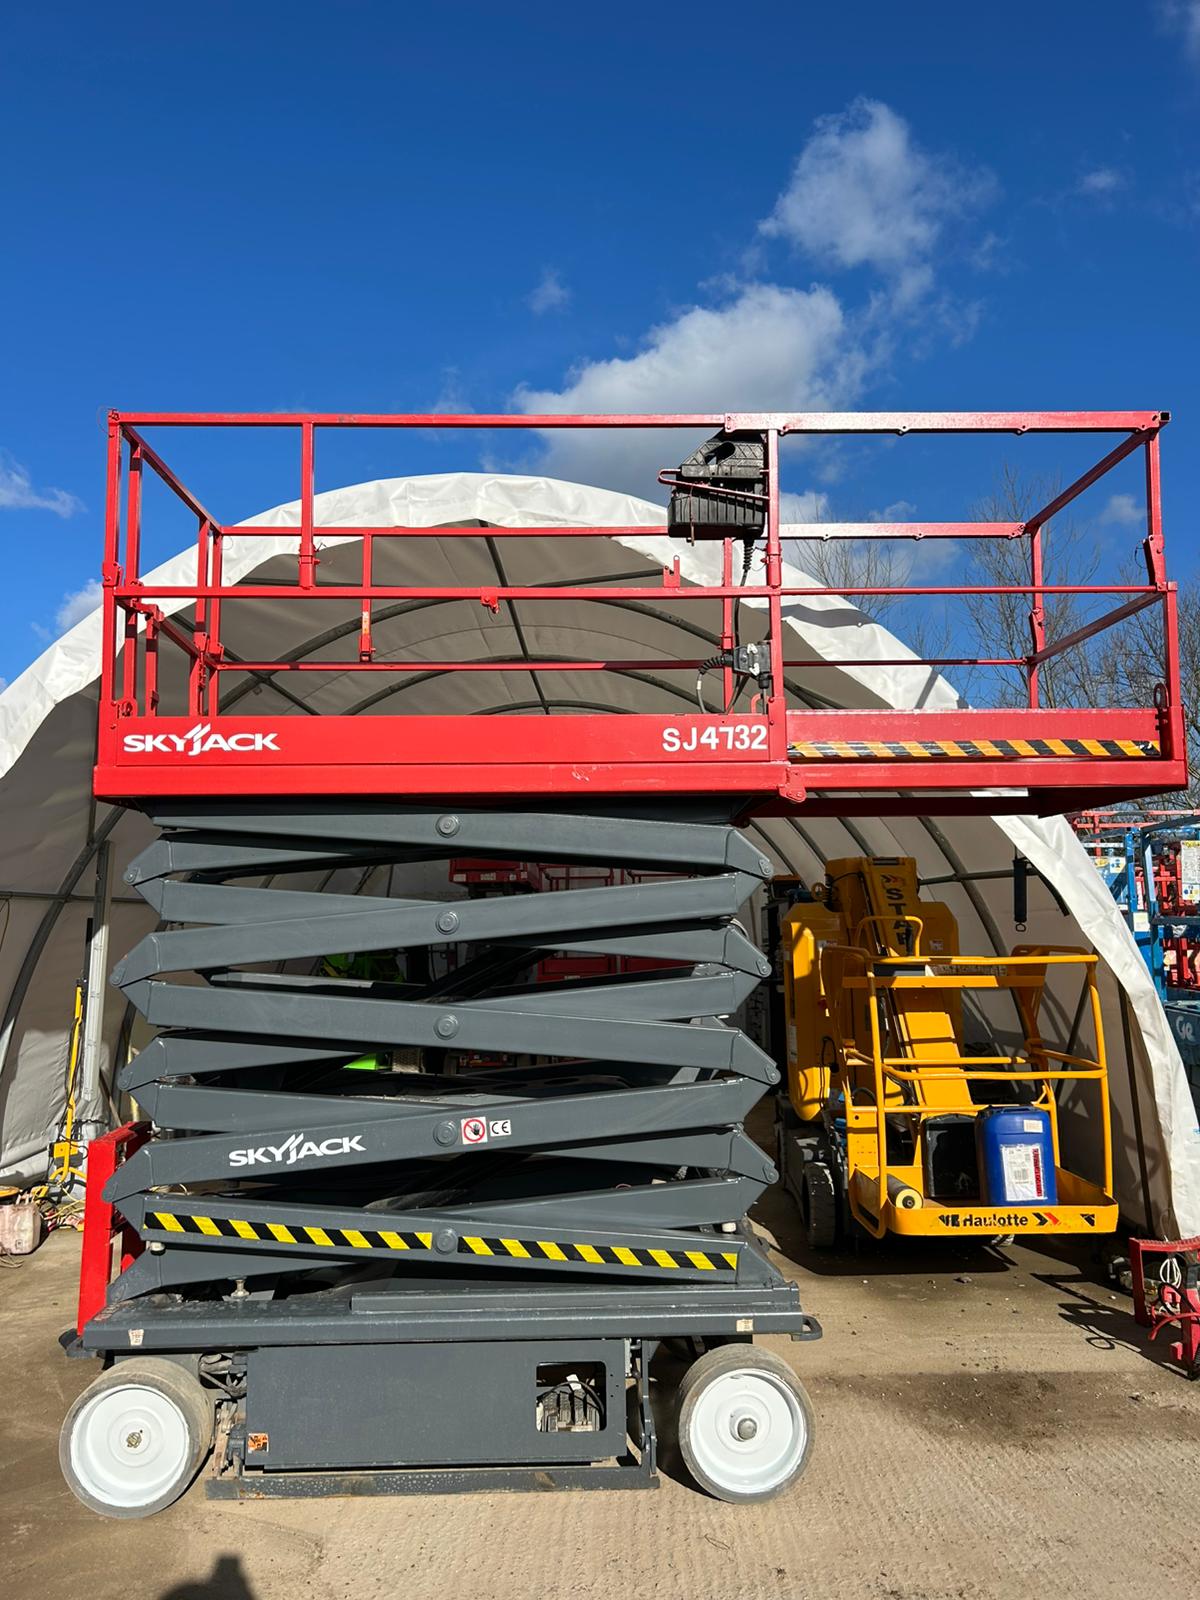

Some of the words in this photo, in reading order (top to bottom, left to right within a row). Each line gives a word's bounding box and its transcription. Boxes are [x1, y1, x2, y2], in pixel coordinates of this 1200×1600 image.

[123, 723, 281, 756] SKYJACK
[662, 724, 768, 752] SJ4732
[491, 1120, 509, 1135] CE
[229, 1132, 367, 1167] SKYJACK
